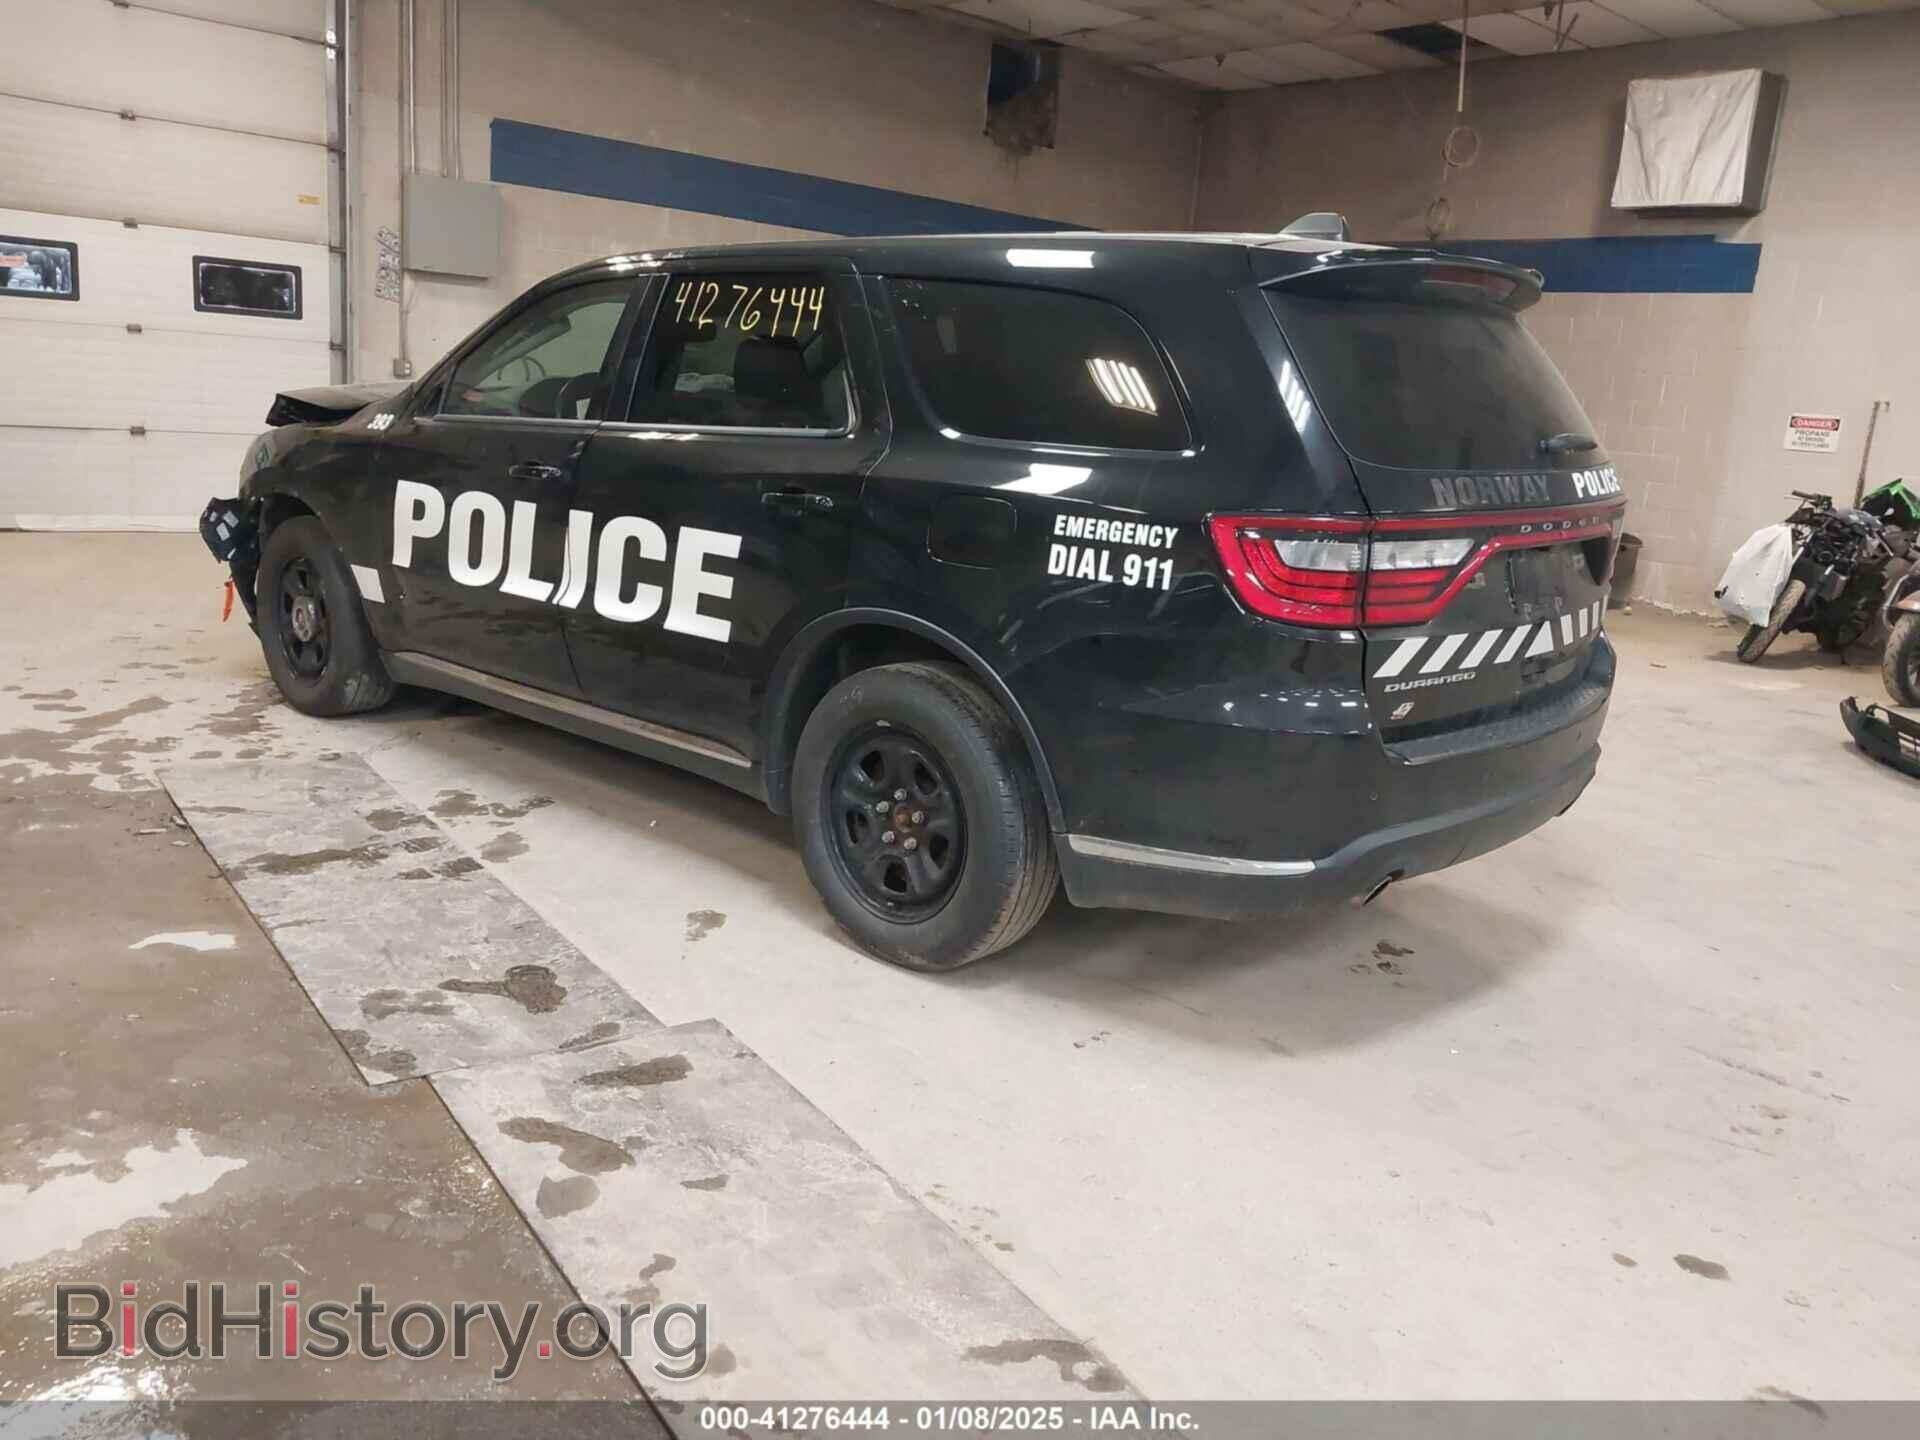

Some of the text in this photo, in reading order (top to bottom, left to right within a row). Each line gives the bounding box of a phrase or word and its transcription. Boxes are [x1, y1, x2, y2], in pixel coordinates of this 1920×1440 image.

[1798, 419, 1832, 429] DANGER
[1430, 467, 1621, 506] NORWAY POLICE
[1053, 514, 1179, 549] EMERGENCY
[392, 479, 742, 643] POLICE
[1047, 543, 1174, 591] DIAL 911
[1384, 671, 1476, 693] DURANGO
